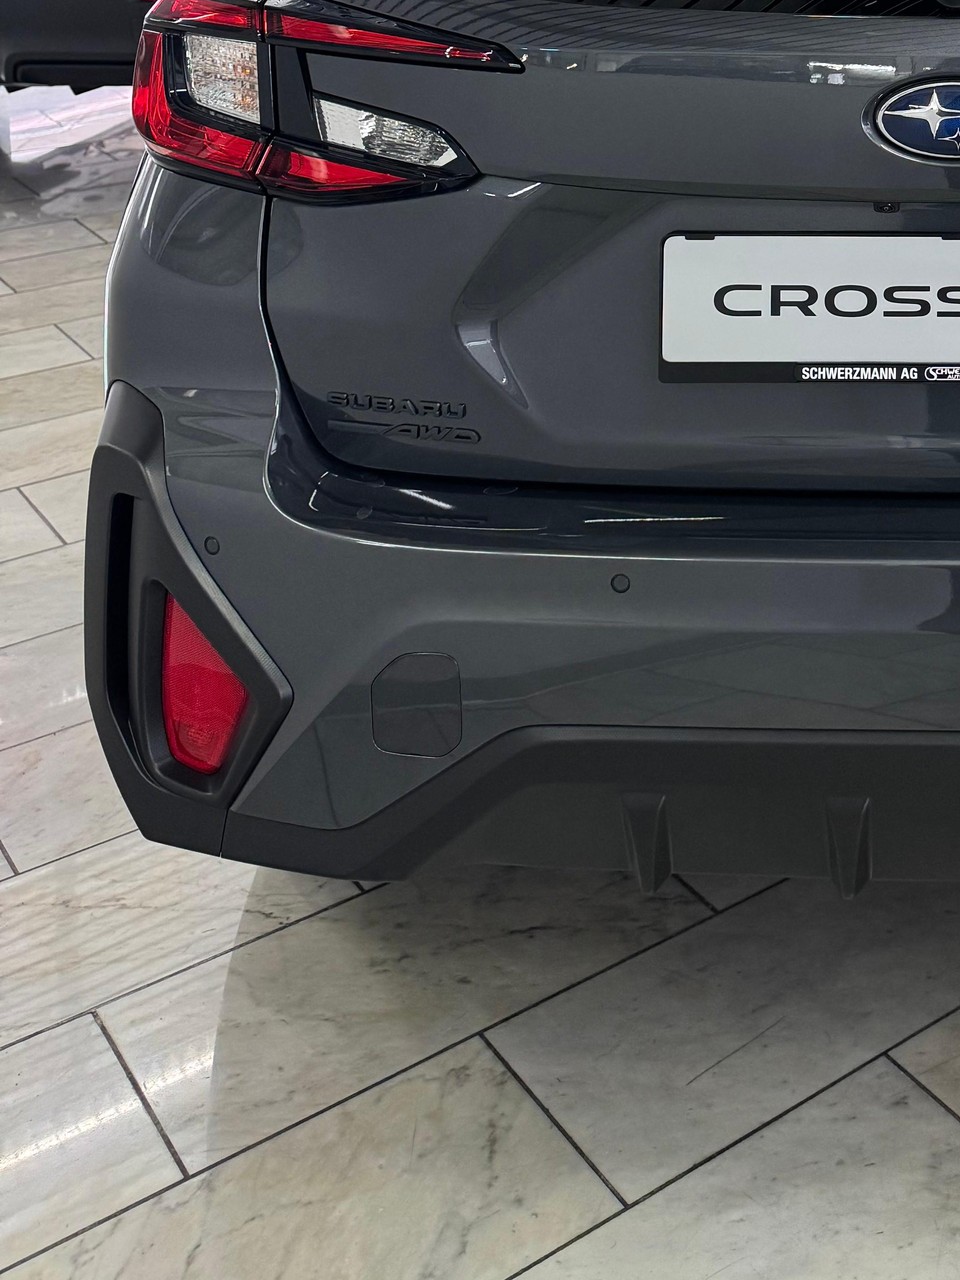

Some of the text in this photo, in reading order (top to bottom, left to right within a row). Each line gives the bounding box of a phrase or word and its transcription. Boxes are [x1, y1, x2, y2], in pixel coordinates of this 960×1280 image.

[801, 367, 919, 380] SCHWERZMANN AG
[327, 391, 468, 419] SUBARU
[381, 423, 482, 445] AWD
